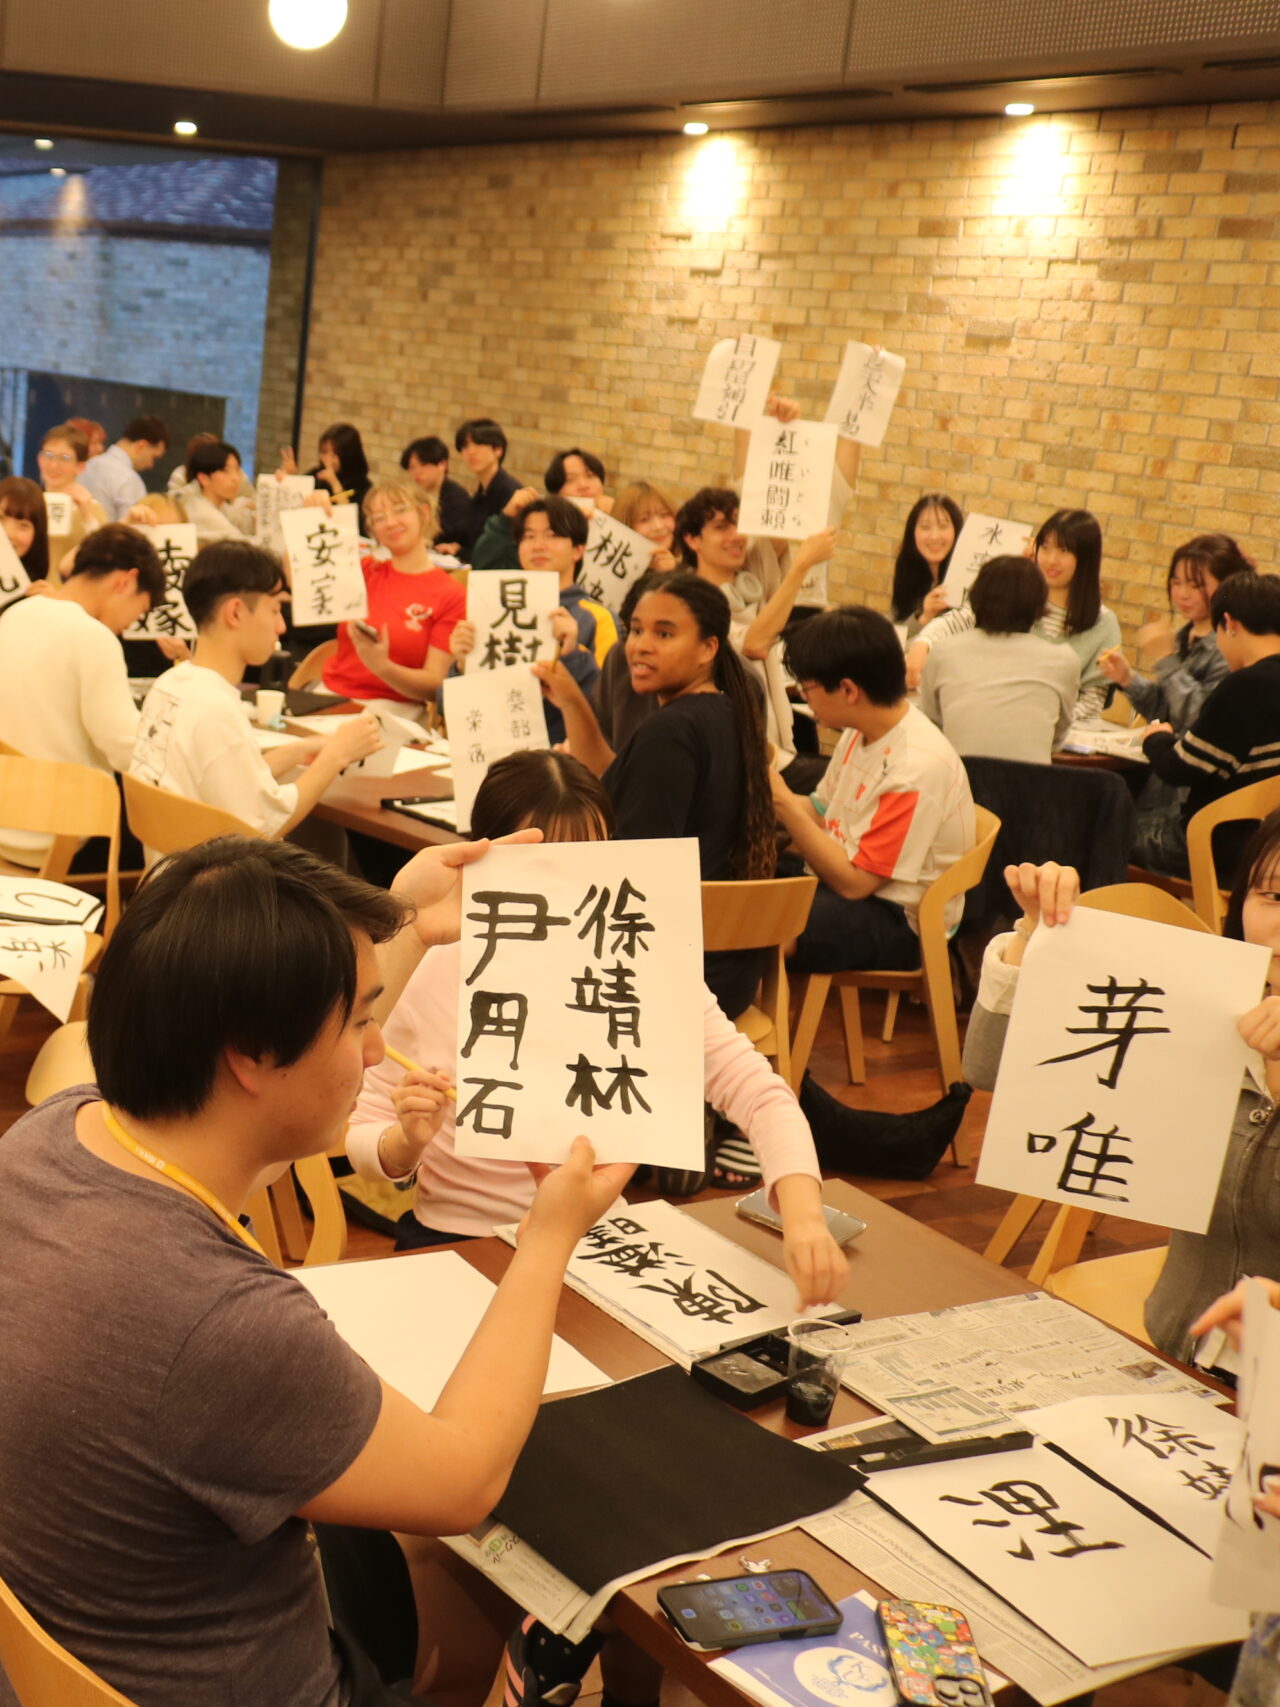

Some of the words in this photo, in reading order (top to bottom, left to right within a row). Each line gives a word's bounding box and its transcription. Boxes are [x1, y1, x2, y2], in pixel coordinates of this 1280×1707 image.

[564, 877, 656, 1117] 徐靖林
[1027, 975, 1172, 1203] 芽唯
